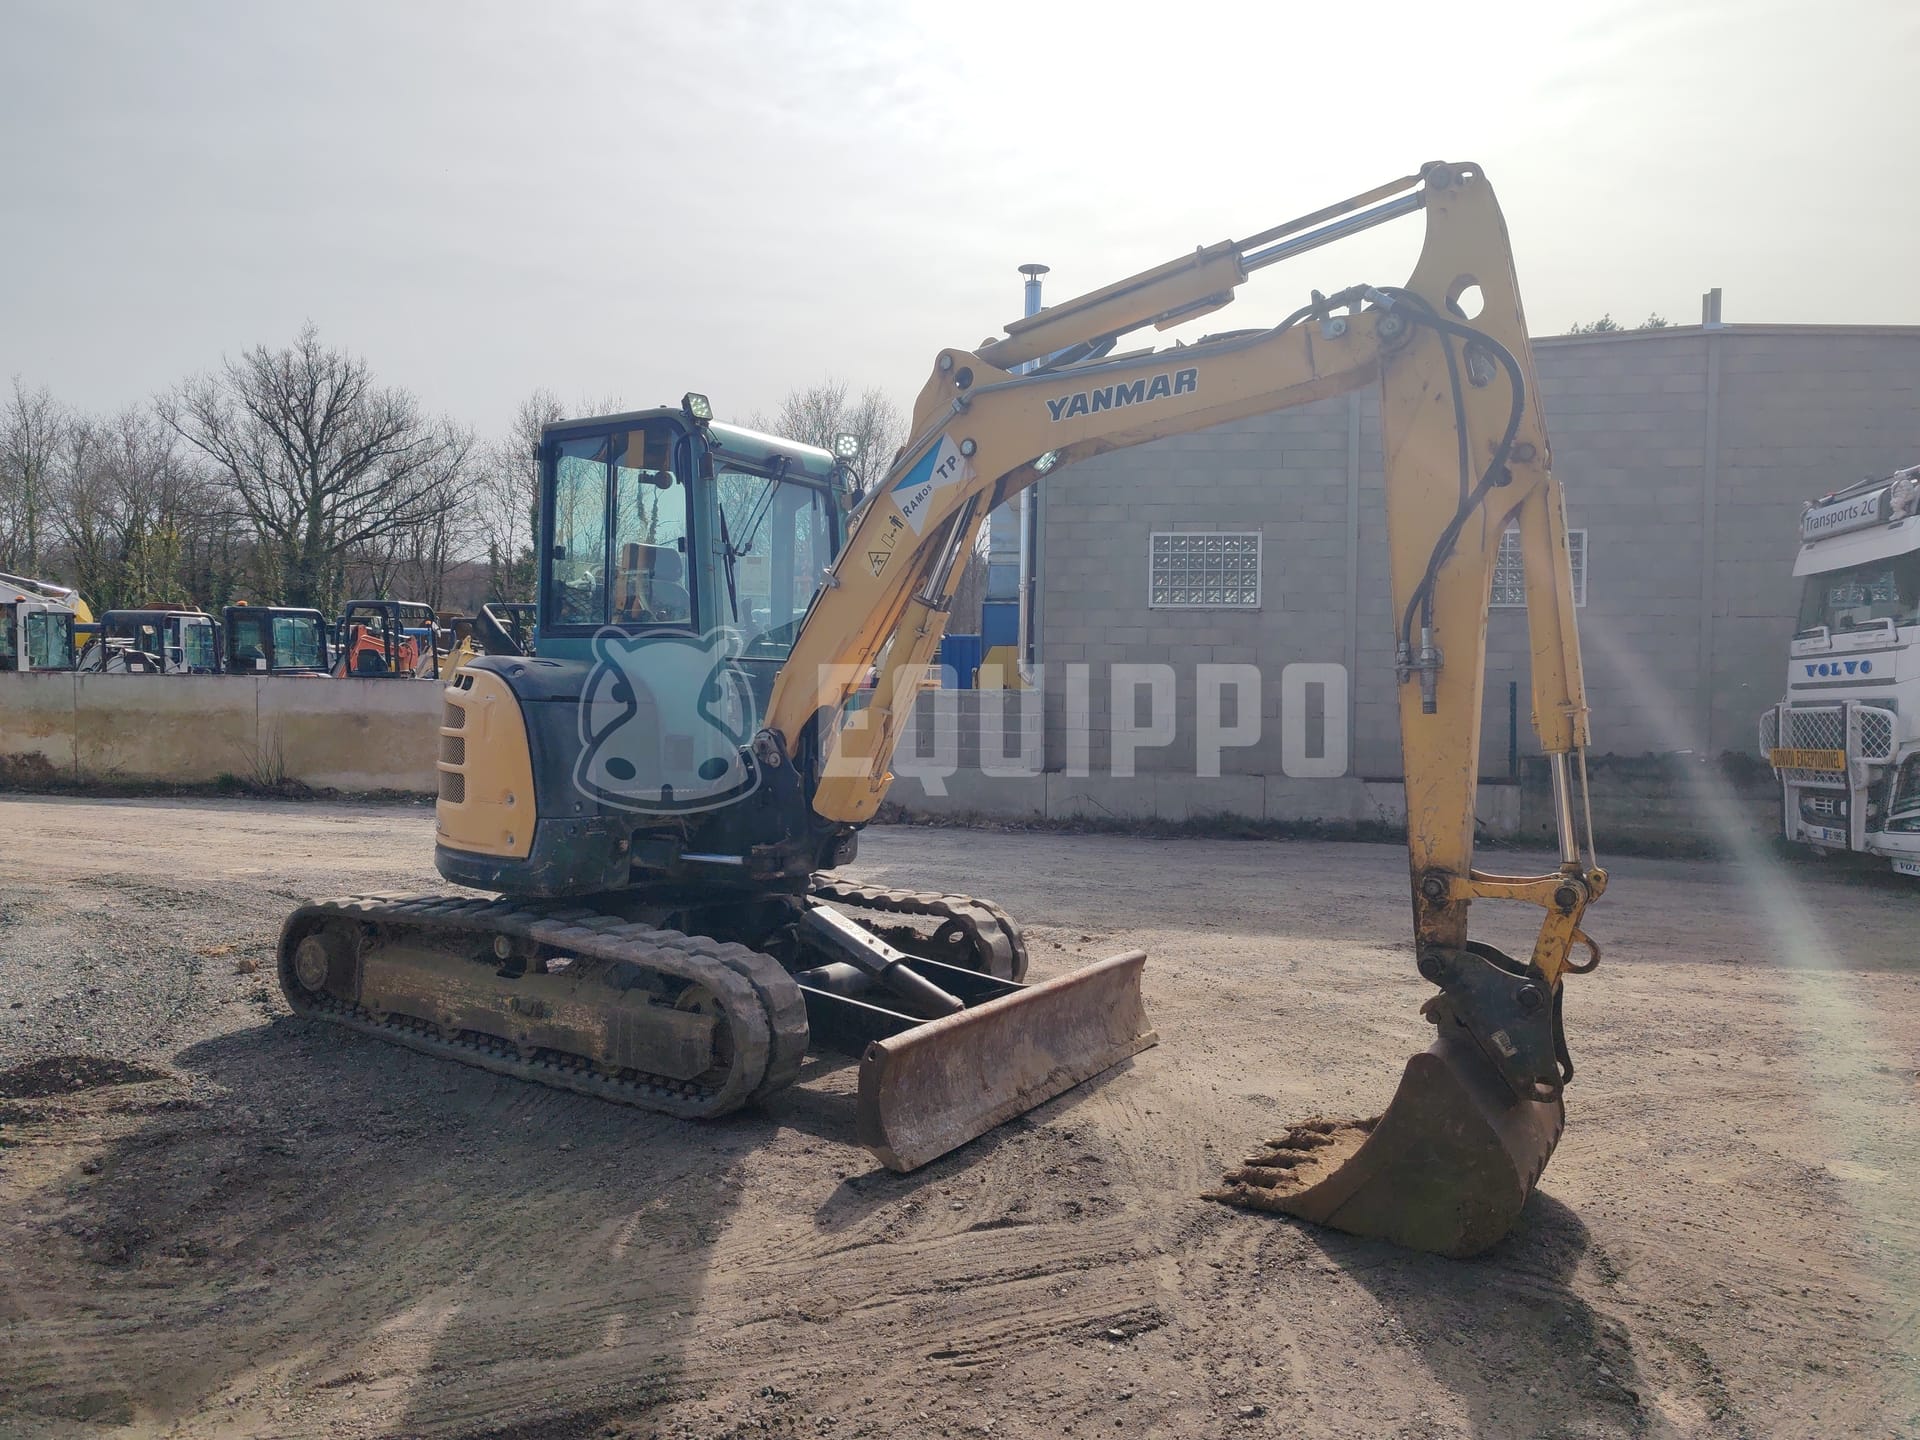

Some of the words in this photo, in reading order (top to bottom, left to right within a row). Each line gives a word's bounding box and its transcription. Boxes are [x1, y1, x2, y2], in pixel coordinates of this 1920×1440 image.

[1046, 367, 1198, 422] YANMAR
[902, 484, 933, 518] RAMOS
[936, 455, 958, 479] TP
[1806, 505, 1858, 532] Transports
[1861, 498, 1876, 516] 2C
[1805, 660, 1873, 677] VOLVO
[1899, 862, 1920, 872] VOL
